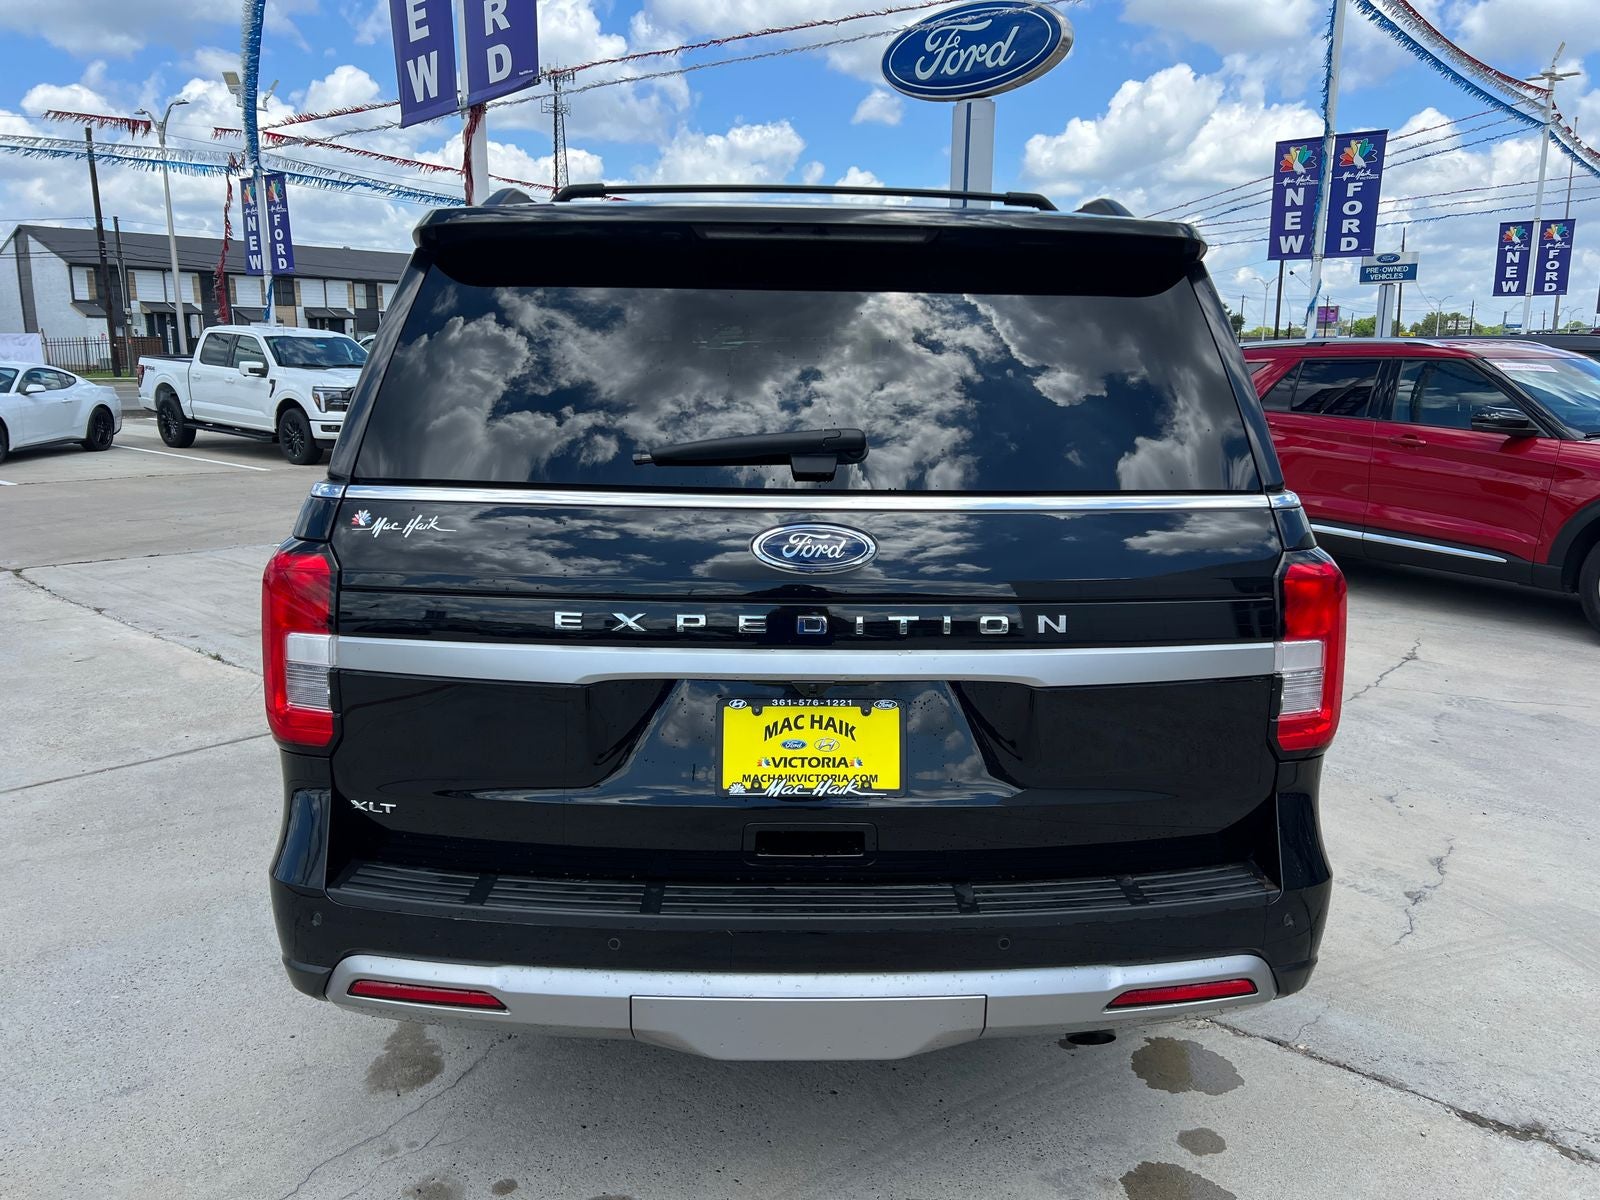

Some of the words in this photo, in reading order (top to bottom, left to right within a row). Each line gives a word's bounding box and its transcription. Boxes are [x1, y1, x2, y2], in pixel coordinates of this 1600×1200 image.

[915, 19, 1020, 80] Ford
[1279, 187, 1305, 254] NEW
[1339, 182, 1364, 252] FORD
[246, 216, 262, 270] NEW
[273, 215, 288, 270] FORD
[1370, 272, 1404, 281] VEHICLES
[1501, 251, 1520, 293] NEW
[1543, 249, 1560, 292] FORD
[363, 516, 402, 538] Mac
[402, 514, 448, 538] Haik
[782, 532, 847, 559] Ford
[553, 611, 1067, 635] EXPEDITION
[771, 699, 852, 707] 361-576-1221
[763, 714, 805, 742] MAC
[810, 714, 857, 742] HAIK
[784, 740, 803, 749] Ford
[771, 756, 849, 769] VICTORIA
[754, 778, 812, 797] Mac
[811, 778, 874, 797] Haik
[350, 799, 397, 814] XLT
